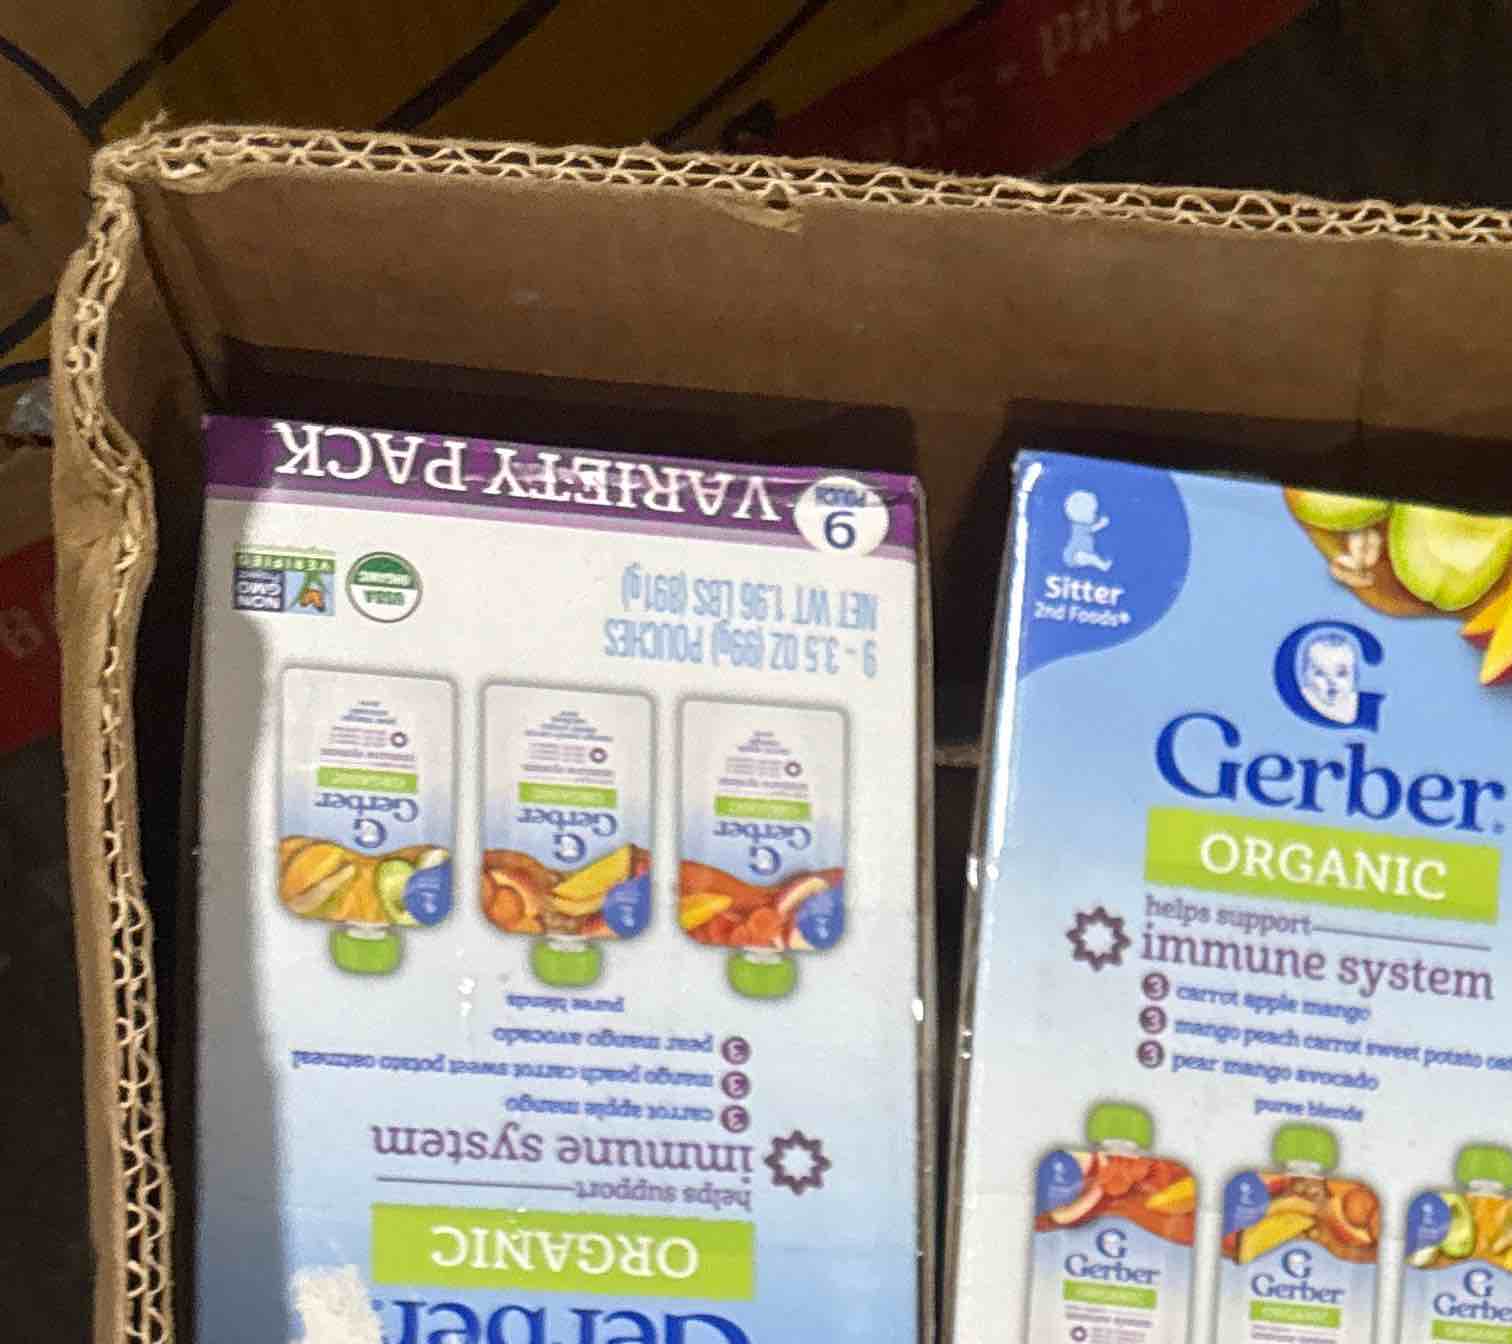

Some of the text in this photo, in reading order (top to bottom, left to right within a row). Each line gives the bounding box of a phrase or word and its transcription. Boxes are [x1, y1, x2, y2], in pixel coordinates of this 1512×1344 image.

[271, 421, 782, 524] VARIETY PACK
[823, 510, 857, 550] 9
[1045, 575, 1126, 607] Sitter
[1155, 711, 1502, 833] Gerber
[315, 792, 420, 821] Gerber
[517, 807, 619, 835] Gerber
[713, 820, 813, 846] Gerber
[1199, 830, 1449, 902] ORGANIC
[1144, 894, 1313, 938] helps support
[1141, 922, 1495, 1002] immune system
[1175, 982, 1239, 1006] carrot
[1171, 1050, 1219, 1073] pear
[585, 1098, 643, 1121] apple
[647, 1105, 714, 1122] carrot
[371, 1122, 754, 1183] immune system
[576, 1178, 752, 1213] helps support
[428, 1223, 698, 1281] ORGANIC
[1064, 1254, 1161, 1285] Gerber
[1250, 1273, 1346, 1305] Gerber
